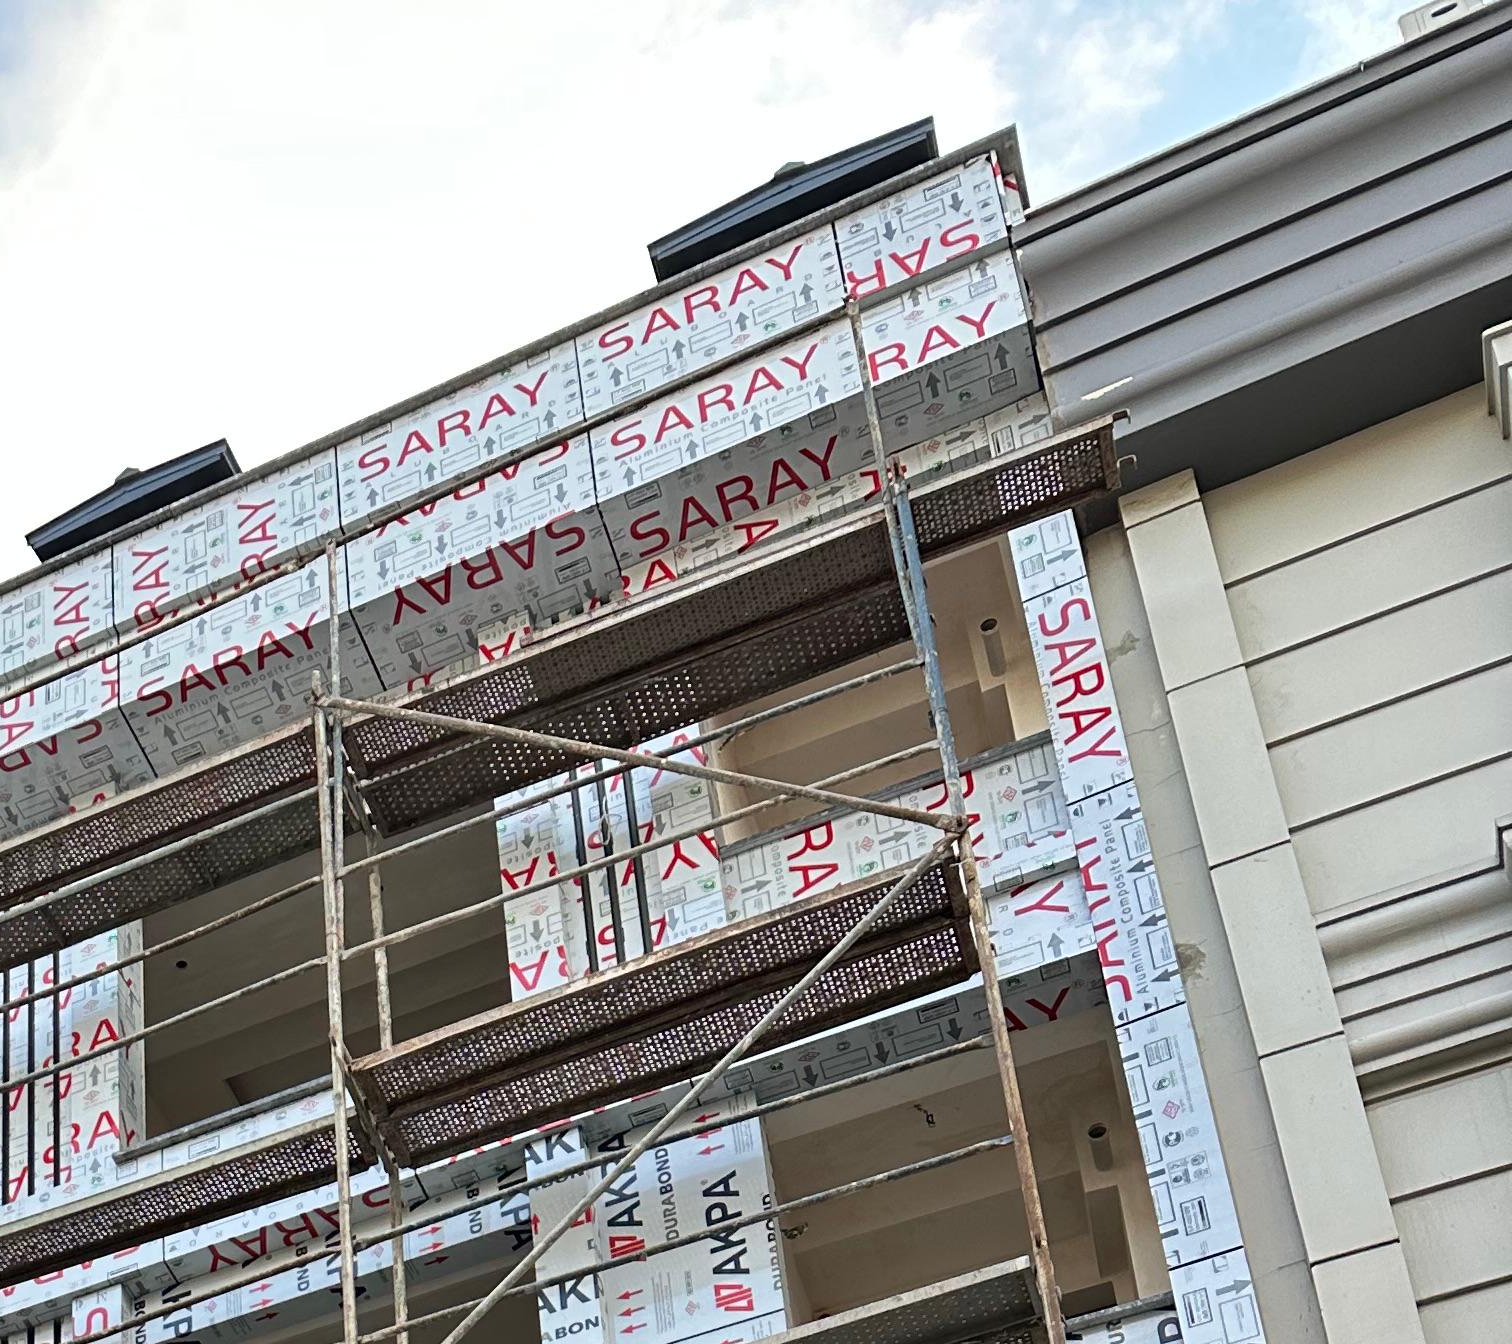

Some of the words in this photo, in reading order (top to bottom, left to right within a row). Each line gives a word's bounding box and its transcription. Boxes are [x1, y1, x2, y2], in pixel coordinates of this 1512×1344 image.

[598, 243, 803, 362] SARAY
[869, 301, 996, 382] RAY
[358, 371, 549, 482] SARAY
[610, 343, 818, 462] SARAY
[619, 435, 693, 467] Aluminium
[700, 400, 777, 433] Composite
[781, 373, 828, 400] Panel
[630, 435, 838, 559] SARAY
[393, 509, 585, 626] SARAY
[137, 610, 319, 717] SARAY
[1039, 597, 1122, 763] SARAY
[1110, 860, 1132, 924] Composite
[1128, 928, 1149, 994] Aluminium
[655, 1147, 679, 1239] DURABOND
[704, 1170, 750, 1275] AKPA
